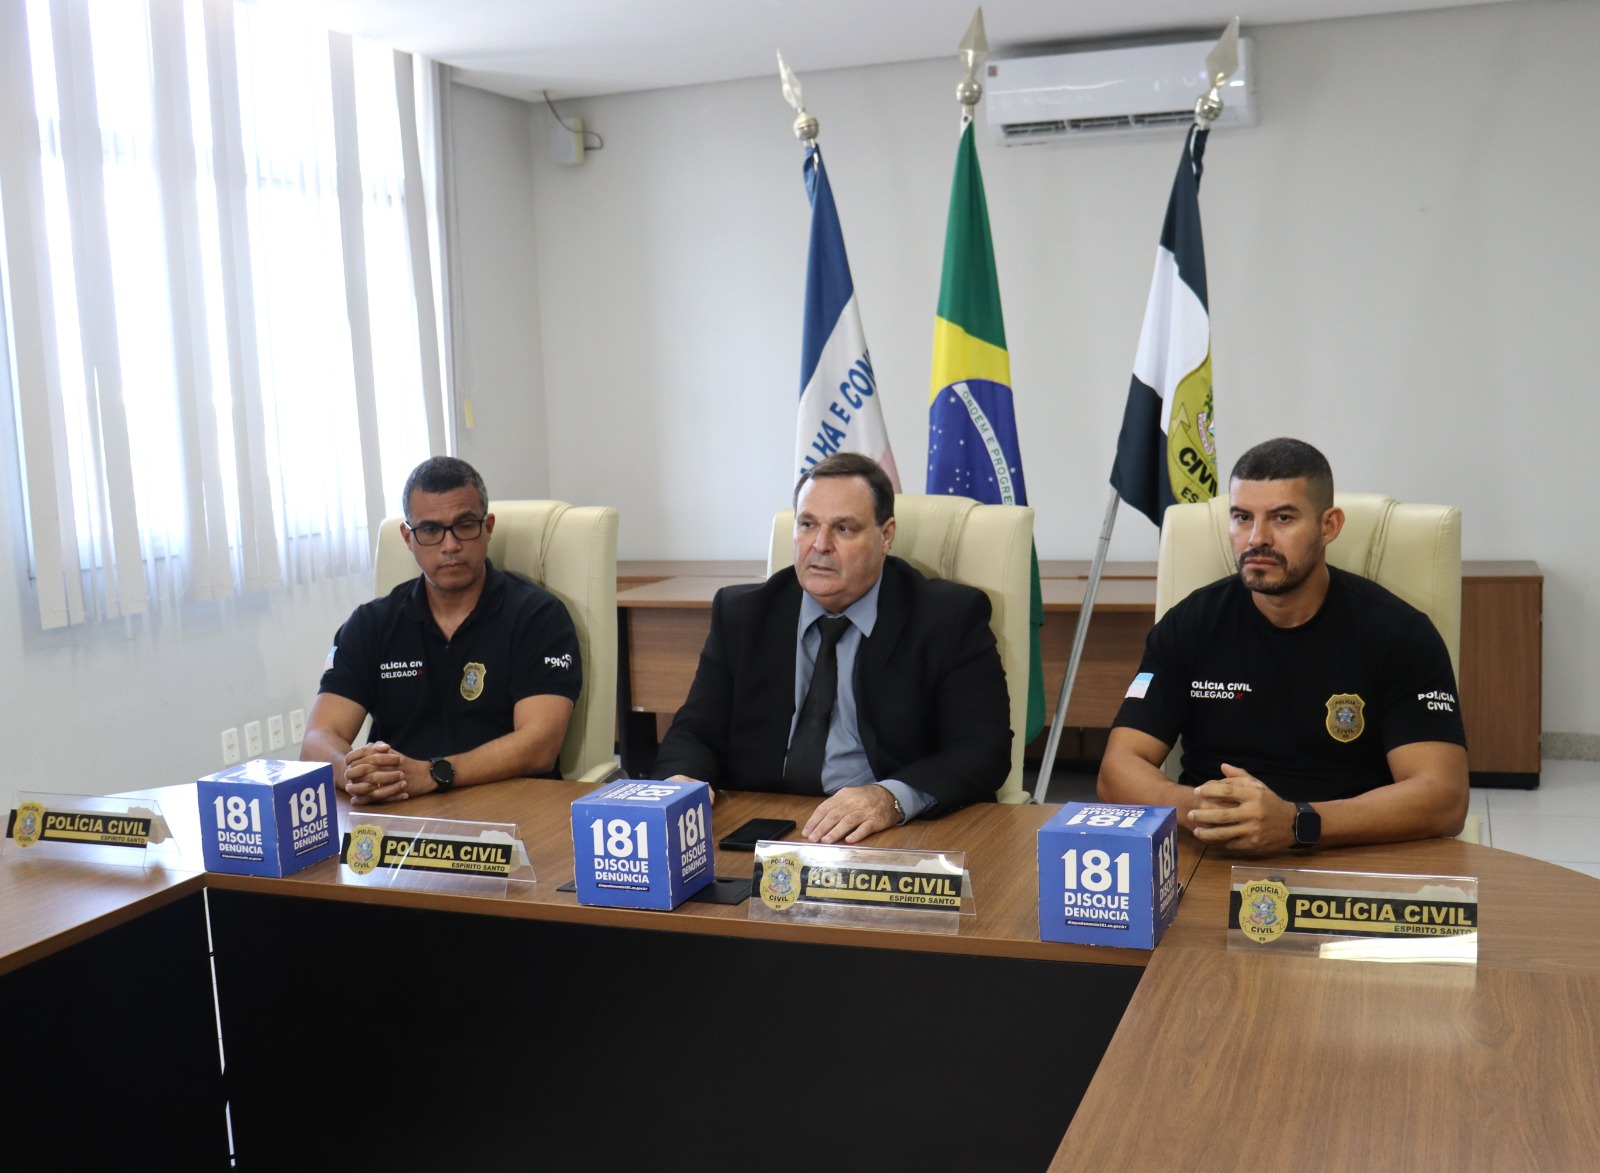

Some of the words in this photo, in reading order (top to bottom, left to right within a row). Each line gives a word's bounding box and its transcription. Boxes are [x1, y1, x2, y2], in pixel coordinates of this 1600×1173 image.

[829, 402, 851, 425] E
[962, 391, 989, 433] ORDEM
[986, 437, 995, 445] E
[991, 448, 1013, 505] PROGRE
[1181, 486, 1199, 503] ES
[381, 670, 417, 679] DELEGADO
[1190, 690, 1235, 700] DELEGADO
[1227, 682, 1252, 692] CIVIL
[1427, 701, 1453, 712] CIVIL
[213, 795, 262, 832] 181
[288, 783, 328, 828] 181
[46, 814, 103, 832] POLÍCIA
[107, 820, 146, 836] CIVIL
[292, 817, 328, 840] DISQUE
[678, 802, 706, 853] 181
[1065, 814, 1139, 829] 181
[217, 830, 263, 845] DISQUE
[590, 818, 649, 859] 181
[218, 842, 263, 855] DENÚNCIA
[386, 839, 454, 860] POLÍCIA
[459, 845, 507, 863] CIVIL
[681, 840, 707, 866] DISQUE
[594, 857, 649, 874] DISQUE
[1160, 830, 1175, 886] 181
[451, 862, 481, 870] ESPÍRITO
[483, 864, 506, 872] SANTO
[1061, 849, 1130, 893] 181
[595, 871, 650, 884] DENÚNCIA
[807, 869, 892, 892] POLÍCIA
[899, 876, 956, 896] CIVIL
[1250, 885, 1279, 895] POLÍCIA
[889, 894, 926, 904] ESPÍRITO
[928, 897, 956, 905] SANTO
[1064, 892, 1130, 910] DISQUE
[1064, 907, 1130, 921] DENÚNCIA
[1295, 898, 1396, 922] POLÍCIA
[1404, 904, 1472, 925] CIVIL
[1251, 926, 1275, 934] CIVIL
[1394, 925, 1438, 935] ESPÍRITO
